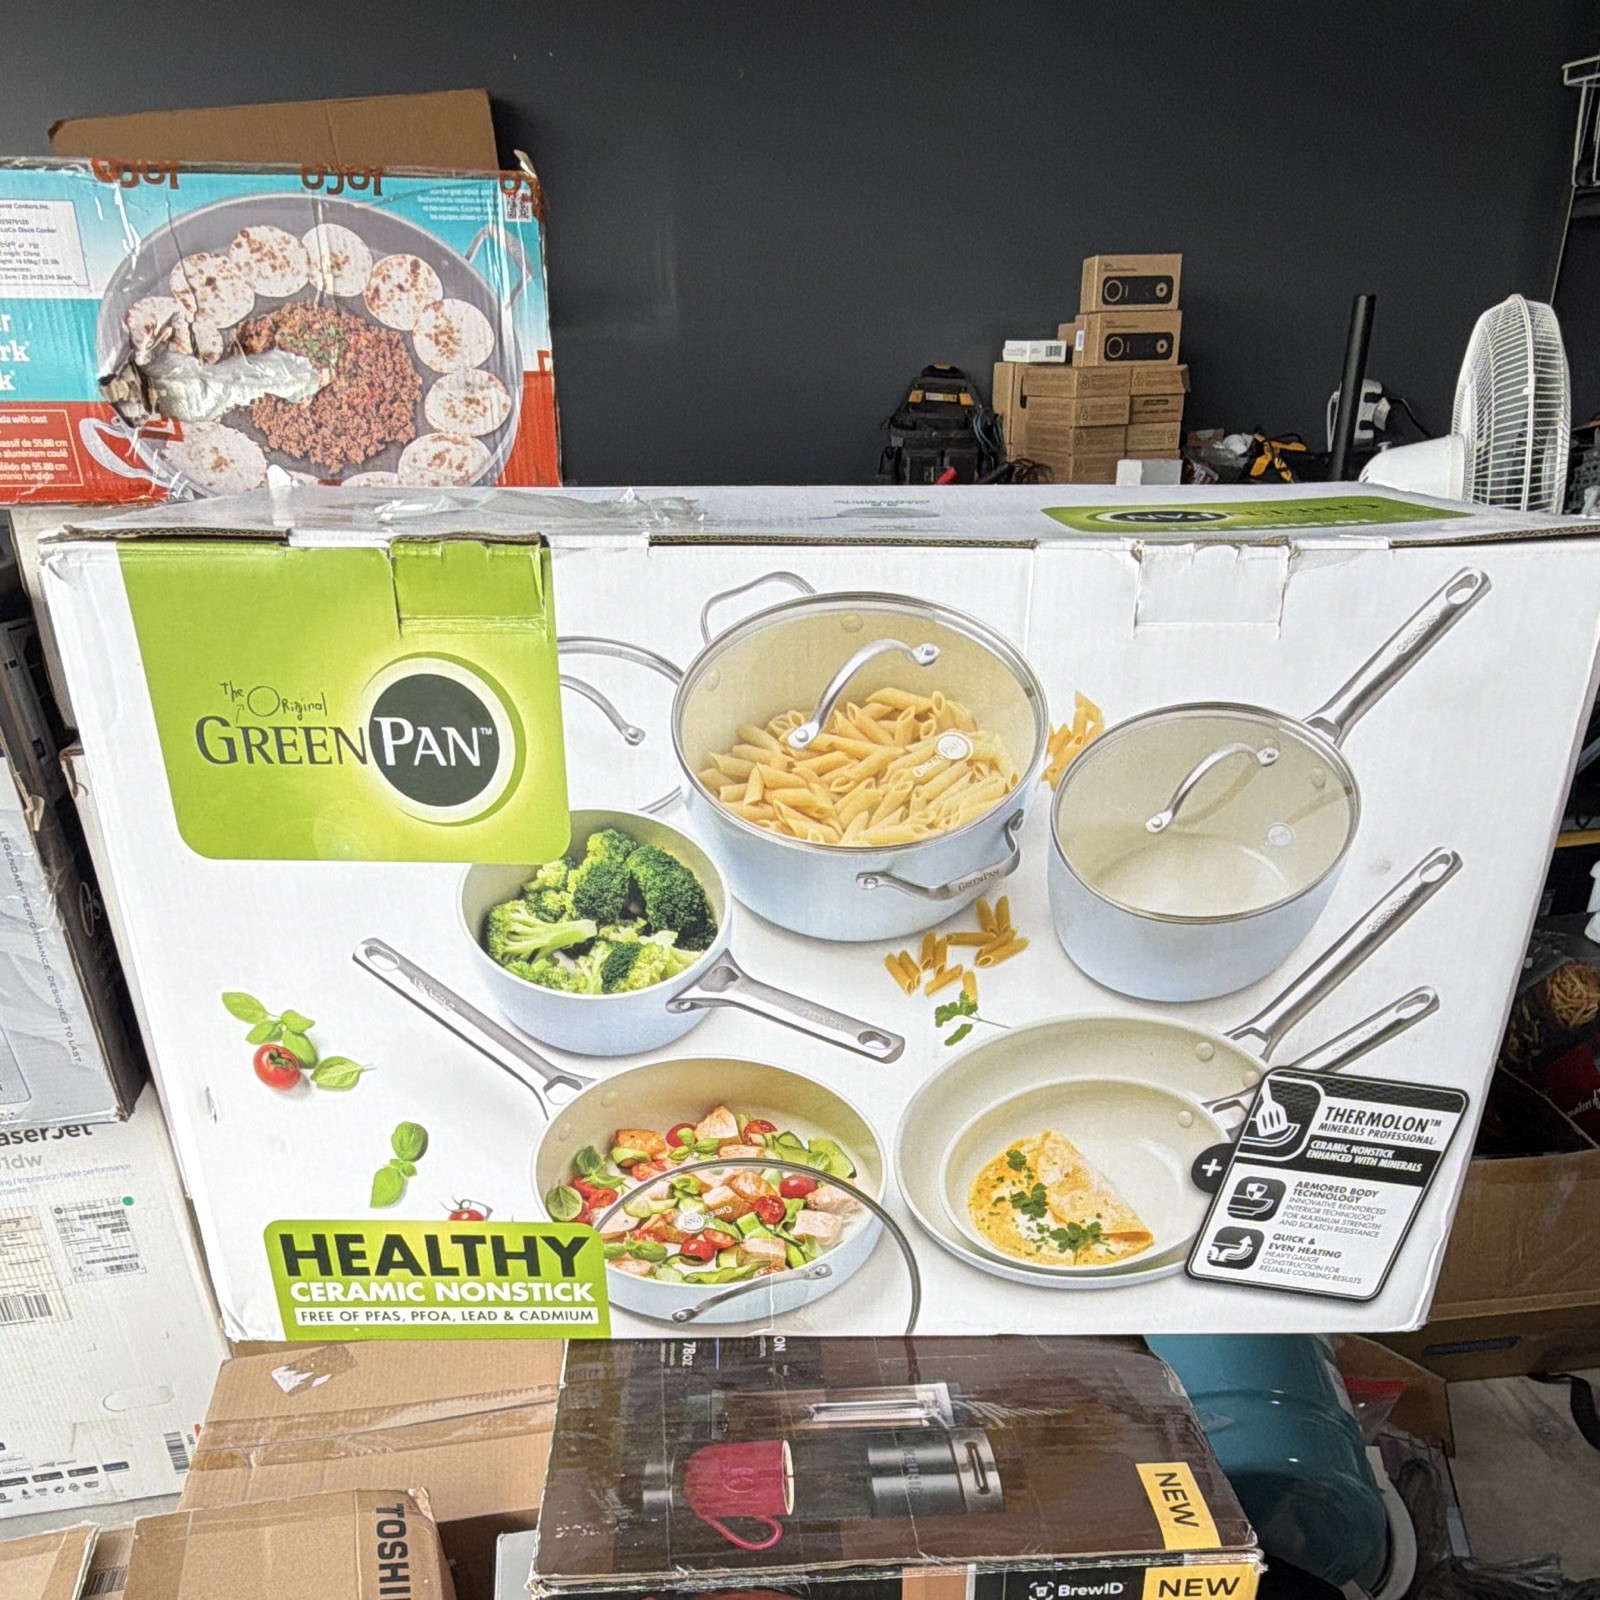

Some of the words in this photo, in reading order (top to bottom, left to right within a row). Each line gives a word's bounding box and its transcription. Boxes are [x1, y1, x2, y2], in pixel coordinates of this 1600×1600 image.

[47, 974, 69, 1025] DESIGNED
[1317, 1122, 1366, 1138] MINERALS
[1310, 1139, 1350, 1153] CERAMIC
[1350, 1143, 1395, 1159] NONSTICK
[0, 1153, 43, 1172] 1dw
[1305, 1150, 1353, 1164] ENHANCED
[1353, 1155, 1379, 1167] WITH
[1379, 1158, 1423, 1173] MINERALS
[1292, 1188, 1363, 1204] TECHNOLOGY
[1295, 1180, 1348, 1195] ARMORED
[1350, 1187, 1380, 1199] BODY
[1285, 1204, 1326, 1216] INTERIOR
[1278, 1219, 1297, 1229] AND
[1297, 1221, 1334, 1234] SCRATCH
[1282, 1211, 1299, 1221] FOR
[1299, 1213, 1341, 1226] MAXIMUM
[1341, 1218, 1382, 1231] STRENGTH
[1272, 1232, 1306, 1245] QUICK
[1308, 1237, 1316, 1246] &
[278, 1233, 591, 1278] HEALTHY
[1267, 1242, 1297, 1254] EVEN
[1297, 1246, 1343, 1259] HEATING
[1325, 1264, 1341, 1274] FOR
[290, 1281, 426, 1303] CERAMIC
[435, 1281, 596, 1303] NONSTICK
[300, 1310, 335, 1322] FREE
[339, 1310, 361, 1322] OF
[365, 1310, 406, 1323] PFAS,
[411, 1310, 456, 1323] PFOA,
[461, 1310, 498, 1322] LEAD
[503, 1310, 515, 1322] &
[519, 1310, 594, 1322] CADMIUM
[681, 1341, 696, 1367] 78oz
[1154, 1472, 1200, 1528] NEW
[375, 1503, 411, 1600] TOSHI
[1158, 1576, 1241, 1598] NEW
